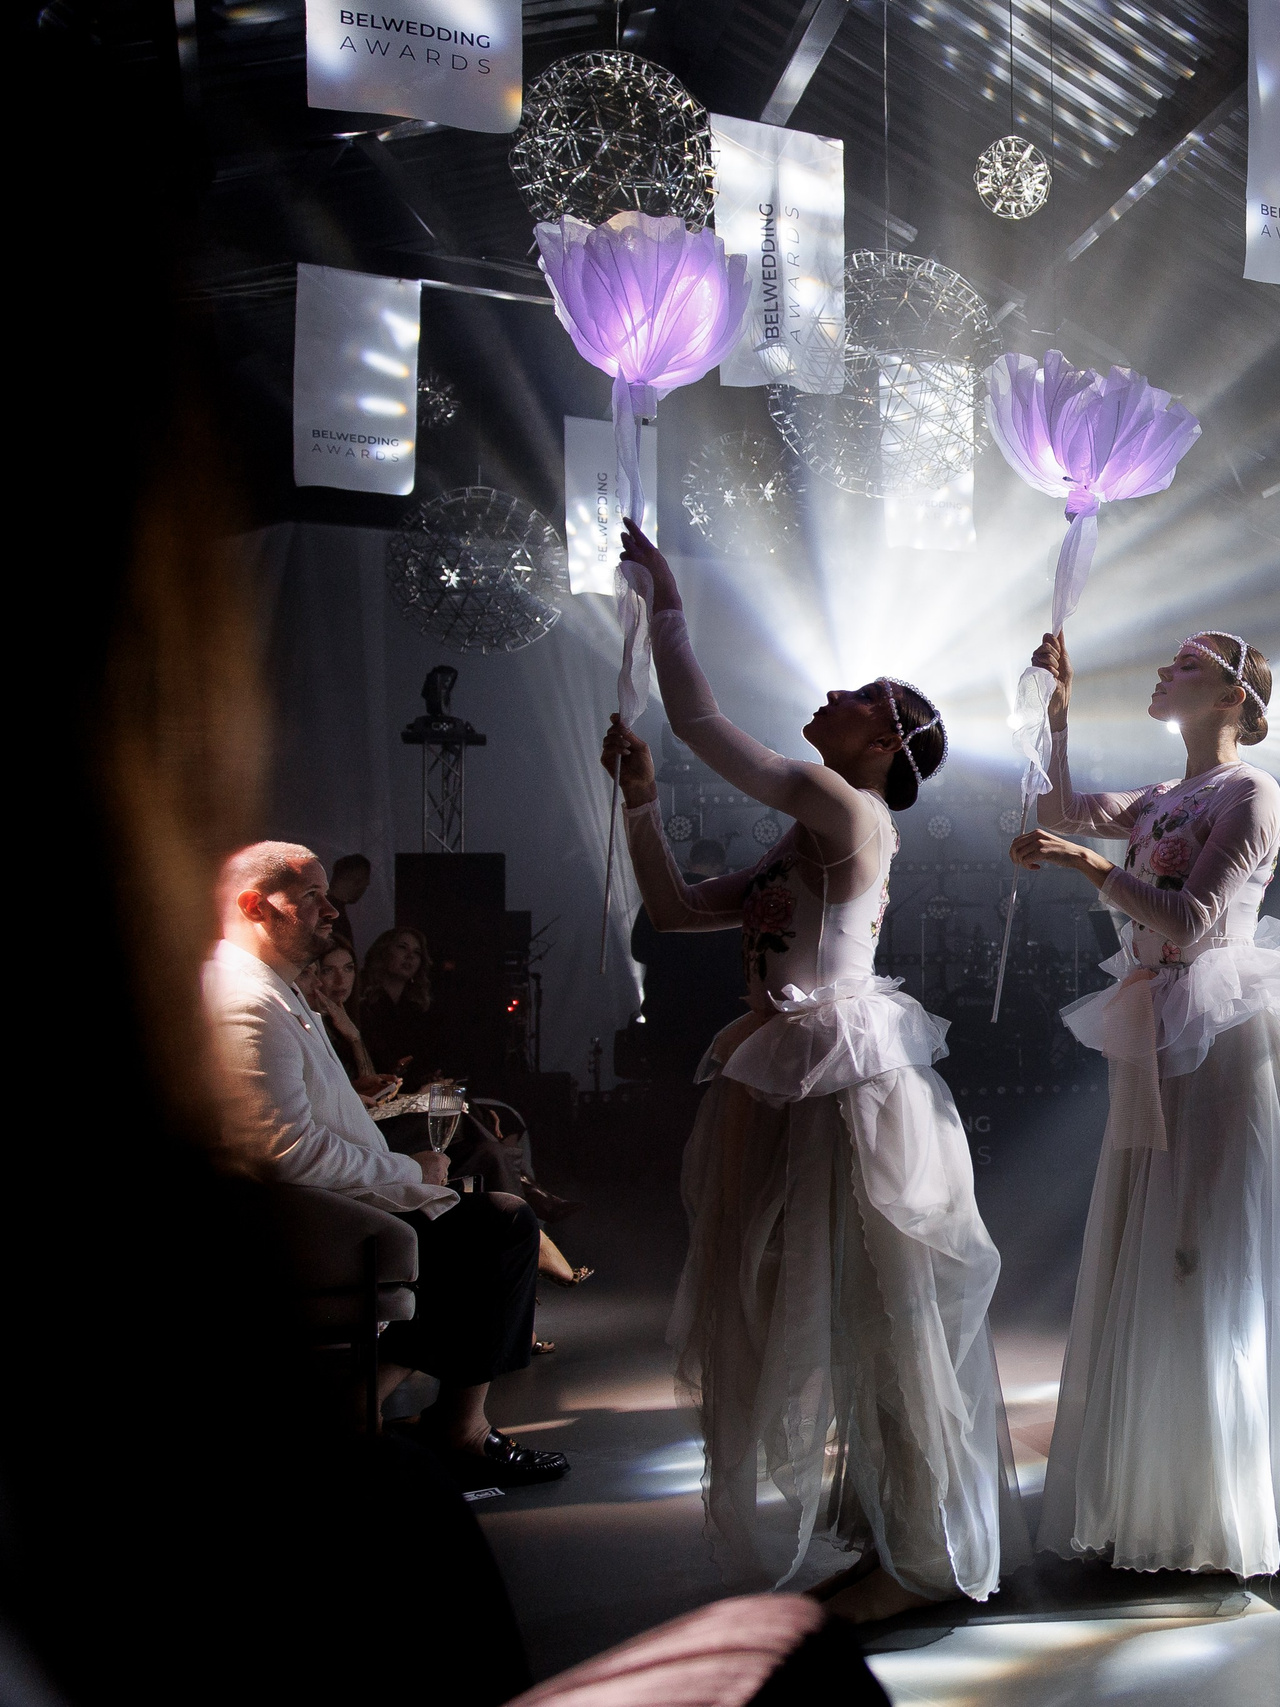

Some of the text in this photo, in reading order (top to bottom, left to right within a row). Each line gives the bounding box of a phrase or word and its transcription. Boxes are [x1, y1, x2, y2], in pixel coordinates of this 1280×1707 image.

[340, 9, 490, 49] BELWEDDING
[339, 35, 491, 75] AWARDS
[759, 203, 780, 340] BELWEDDING
[784, 205, 802, 345] AWARDS
[311, 443, 400, 463] AWARDS
[312, 428, 400, 447] BELWEDDING
[597, 472, 608, 562] BELWEDDING
